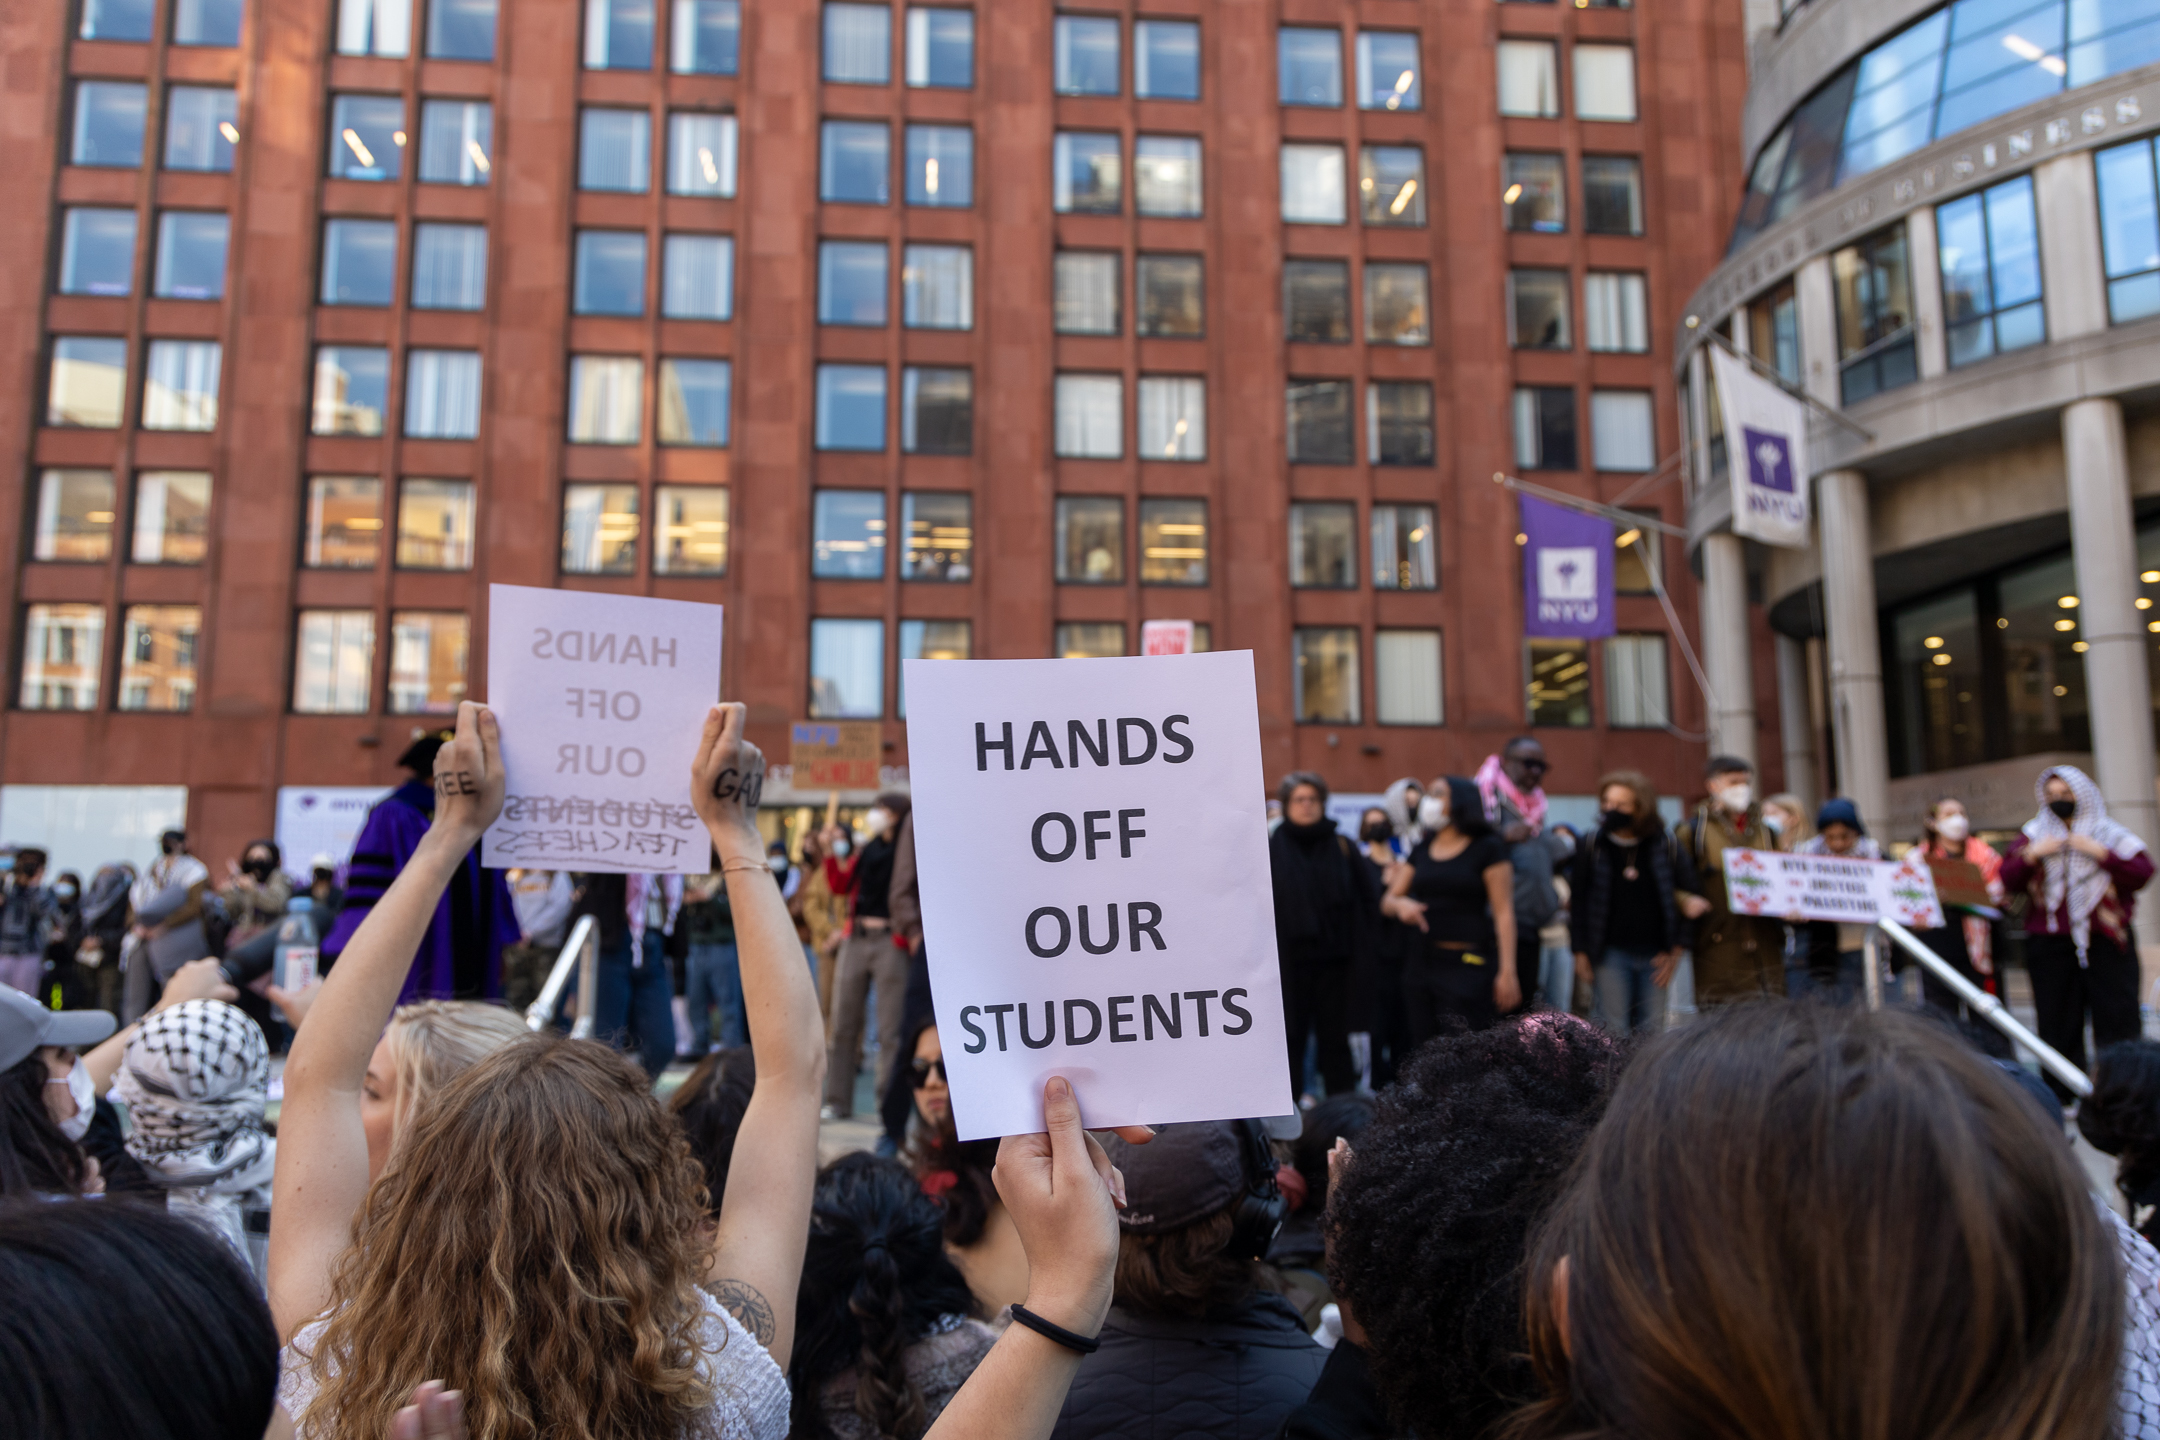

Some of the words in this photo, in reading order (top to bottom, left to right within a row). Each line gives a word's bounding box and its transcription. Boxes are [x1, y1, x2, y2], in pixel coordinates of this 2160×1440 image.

[1538, 600, 1598, 623] NYU
[974, 714, 1194, 771] HANDS
[1031, 808, 1147, 862] OFF
[1025, 901, 1167, 958] OUR
[959, 988, 1253, 1054] STUDENTS
